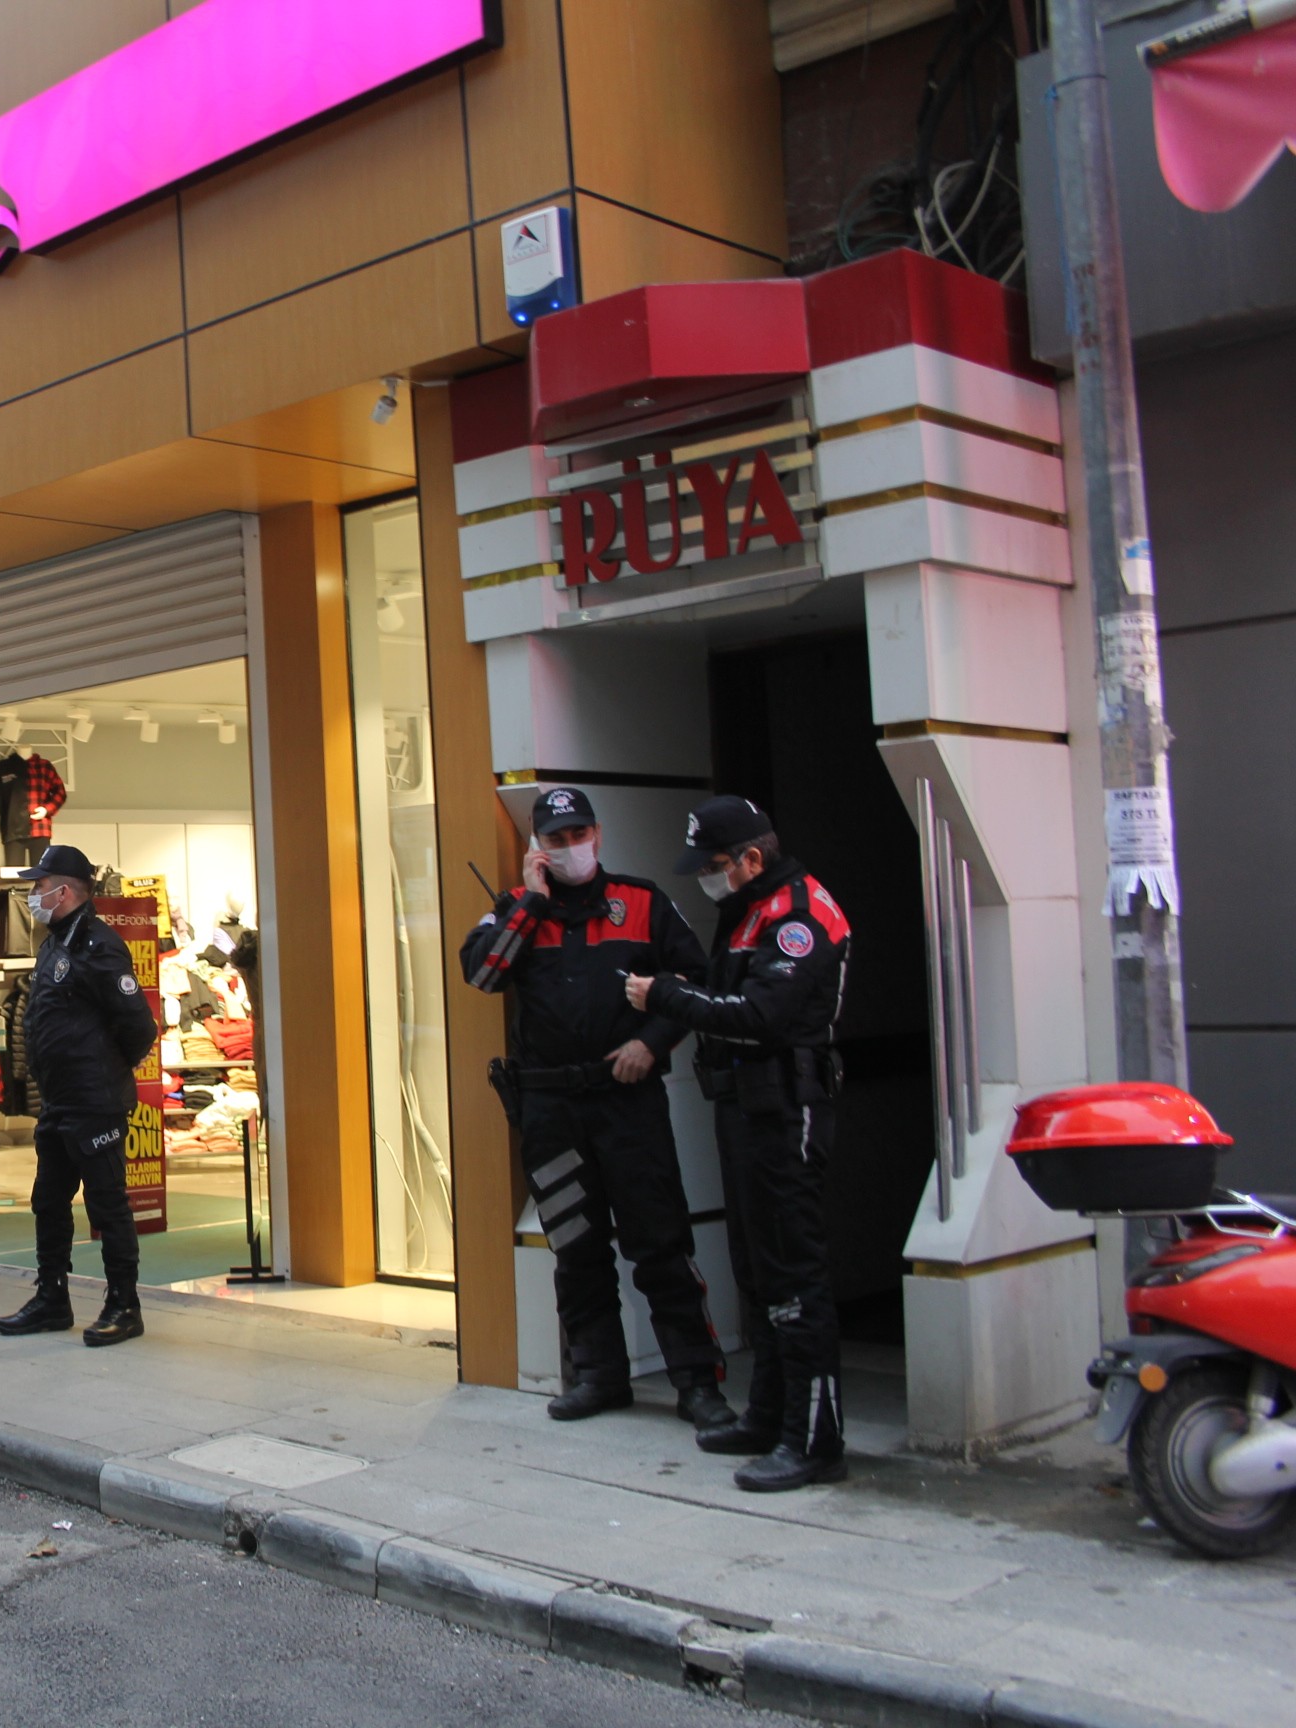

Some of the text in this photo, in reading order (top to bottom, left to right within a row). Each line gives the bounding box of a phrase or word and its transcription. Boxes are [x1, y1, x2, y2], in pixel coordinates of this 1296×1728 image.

[559, 449, 804, 587] RÜYA
[125, 941, 157, 959] MIZI
[92, 1128, 120, 1149] POLİS
[125, 1127, 162, 1159] ONU
